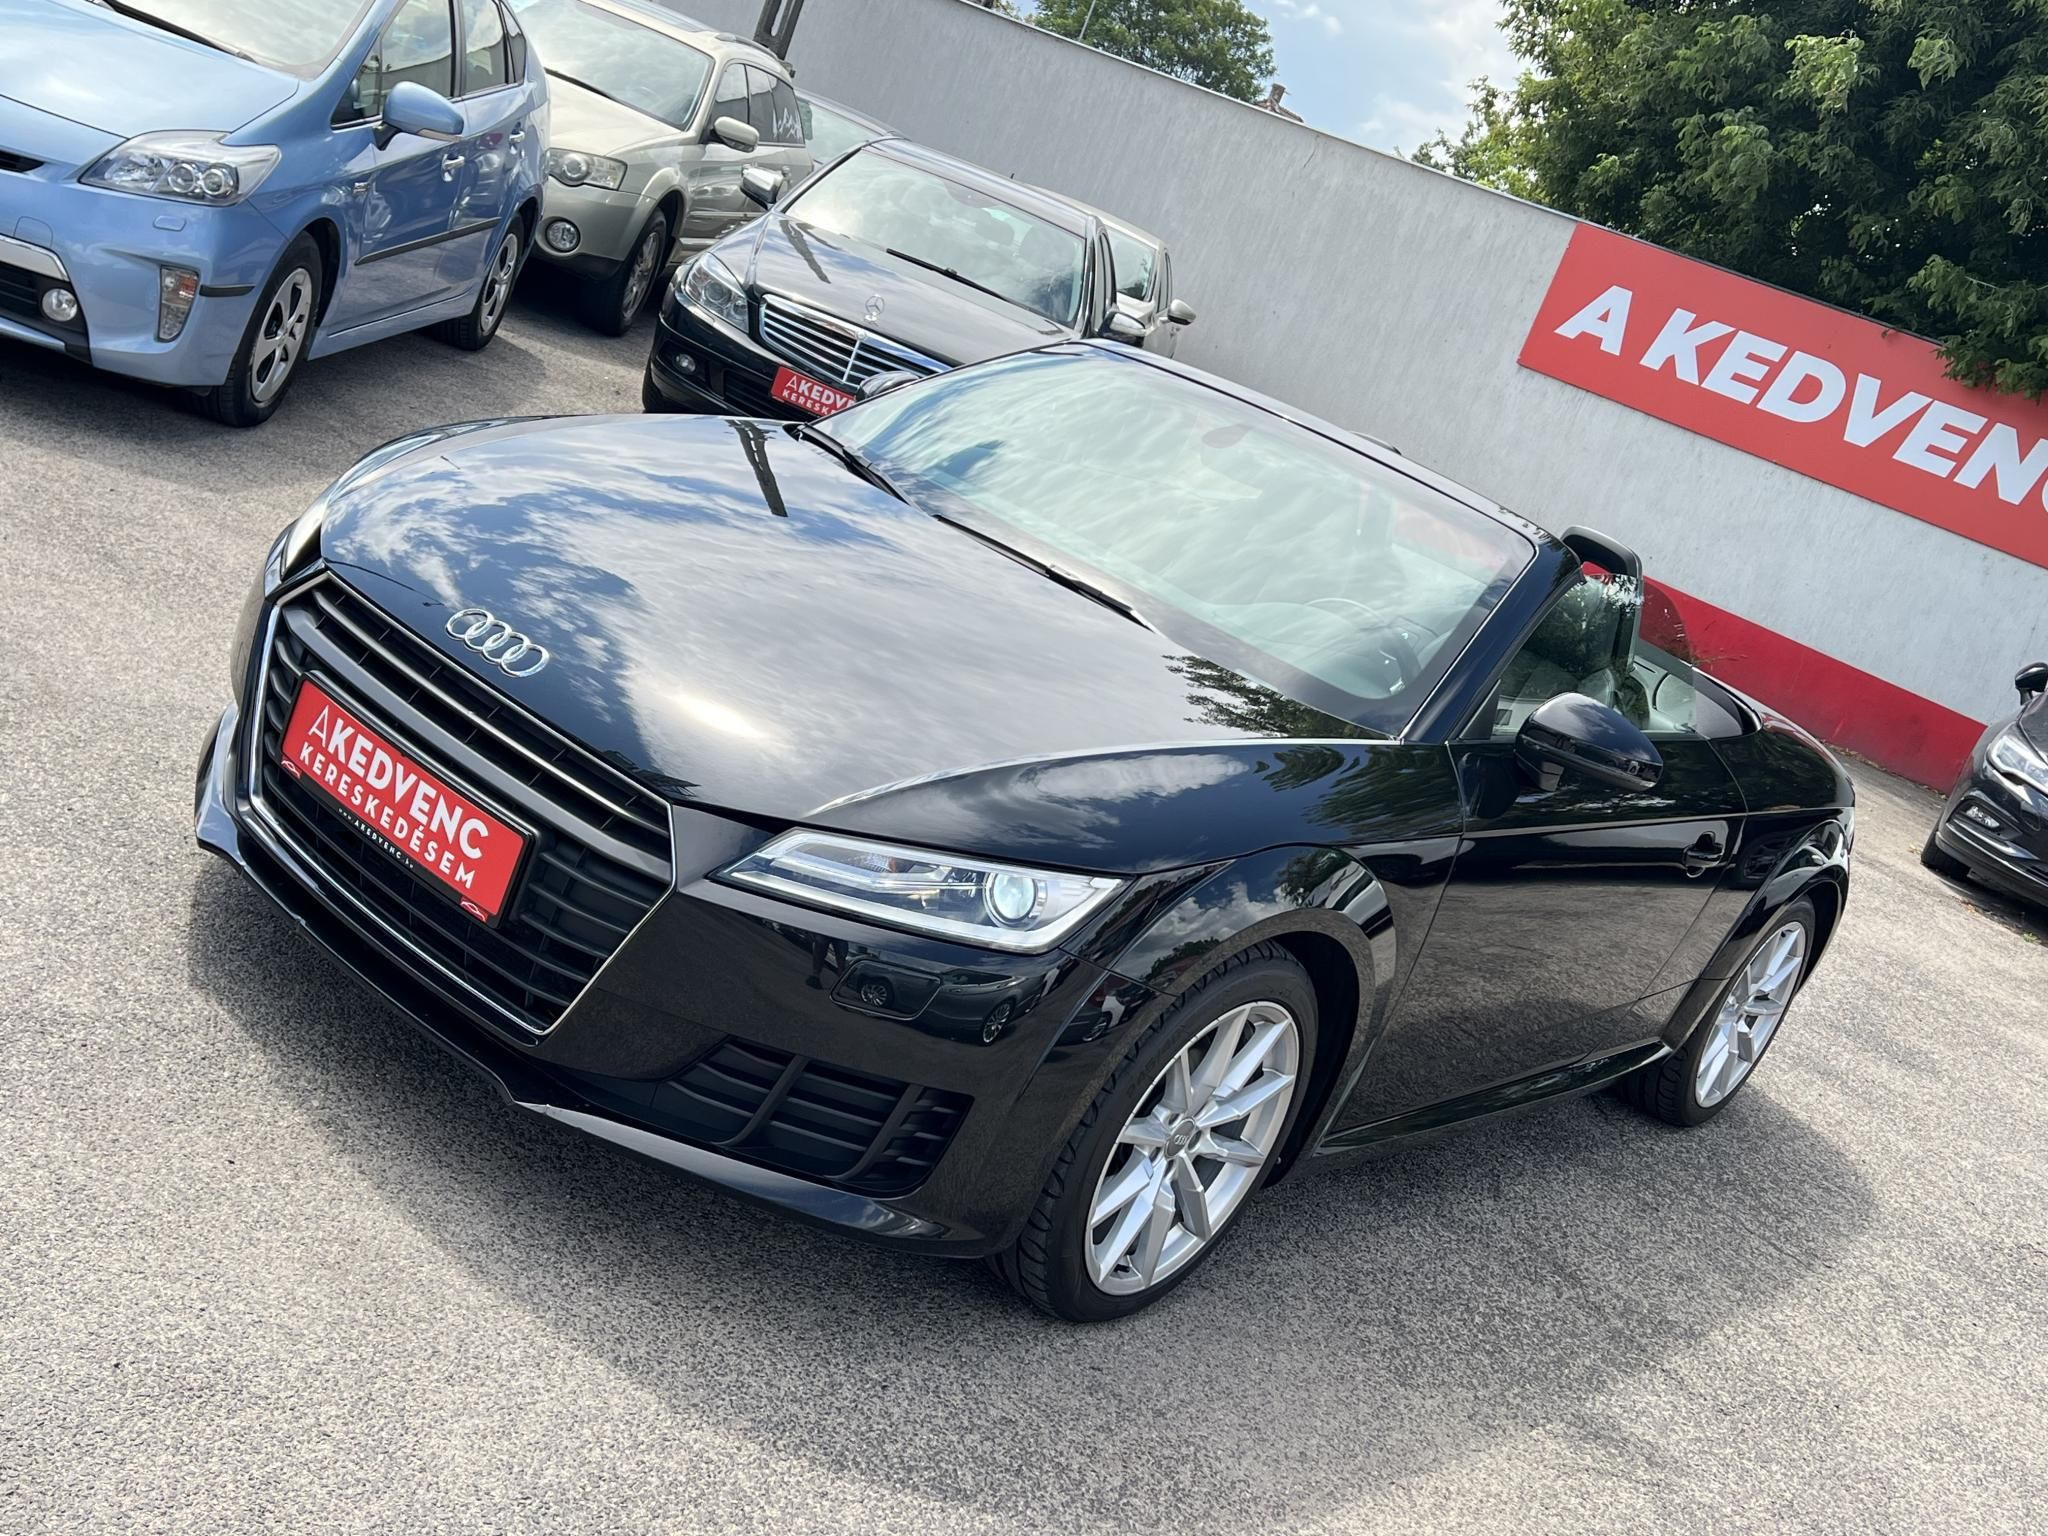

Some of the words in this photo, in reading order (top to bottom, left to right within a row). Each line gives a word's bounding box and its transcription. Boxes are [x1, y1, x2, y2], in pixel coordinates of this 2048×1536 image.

[1554, 285, 1632, 356] A
[1639, 308, 2048, 512] KEDVEN
[300, 742, 476, 889] KERESKEDÉSEM
